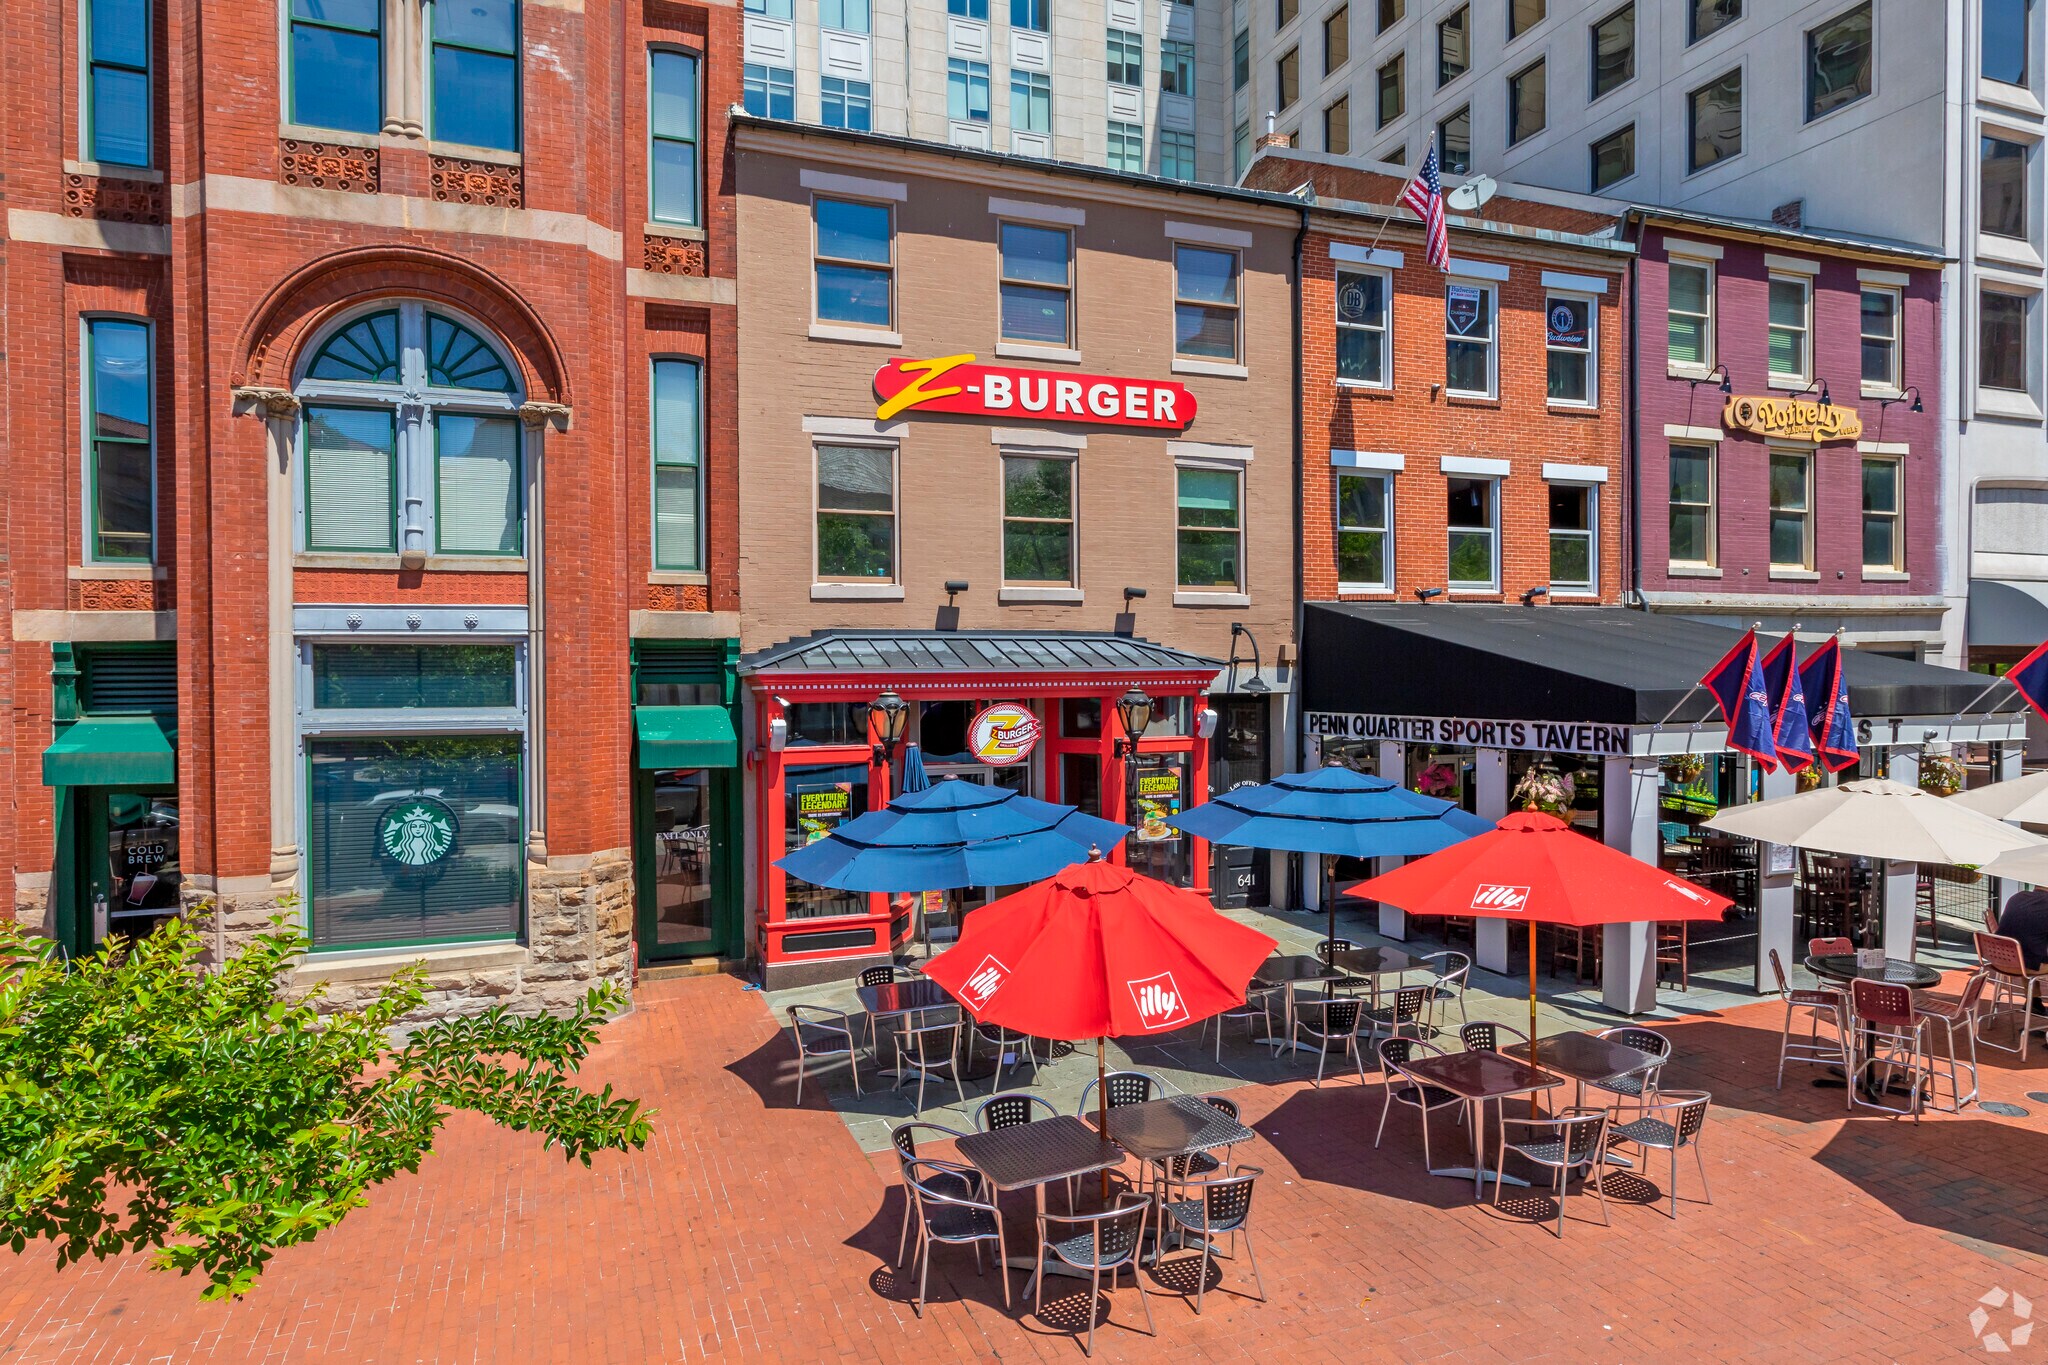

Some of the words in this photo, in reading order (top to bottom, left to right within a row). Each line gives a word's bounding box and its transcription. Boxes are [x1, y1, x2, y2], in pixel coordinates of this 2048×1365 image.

[1346, 291, 1361, 307] DB
[1547, 331, 1584, 343] Budweiser
[1758, 398, 1846, 442] Potbelly
[1309, 713, 1349, 735] PENN
[1353, 714, 1435, 742] QUARTER
[1439, 719, 1526, 747] SPORTS
[1531, 723, 1631, 754] TAVERN
[1857, 719, 1873, 744] S
[1888, 718, 1904, 744] T
[1140, 776, 1179, 785] EVERYTHING
[1139, 783, 1179, 792] LEGENDARY
[1229, 782, 1241, 791] LAW
[801, 792, 848, 803] EVERYTHING
[801, 800, 848, 810] LEGENDARY
[655, 832, 681, 840] EXIT
[682, 830, 709, 839] ONLY
[128, 845, 164, 855] COLD
[128, 854, 165, 864] BREW
[1237, 873, 1256, 887] 641
